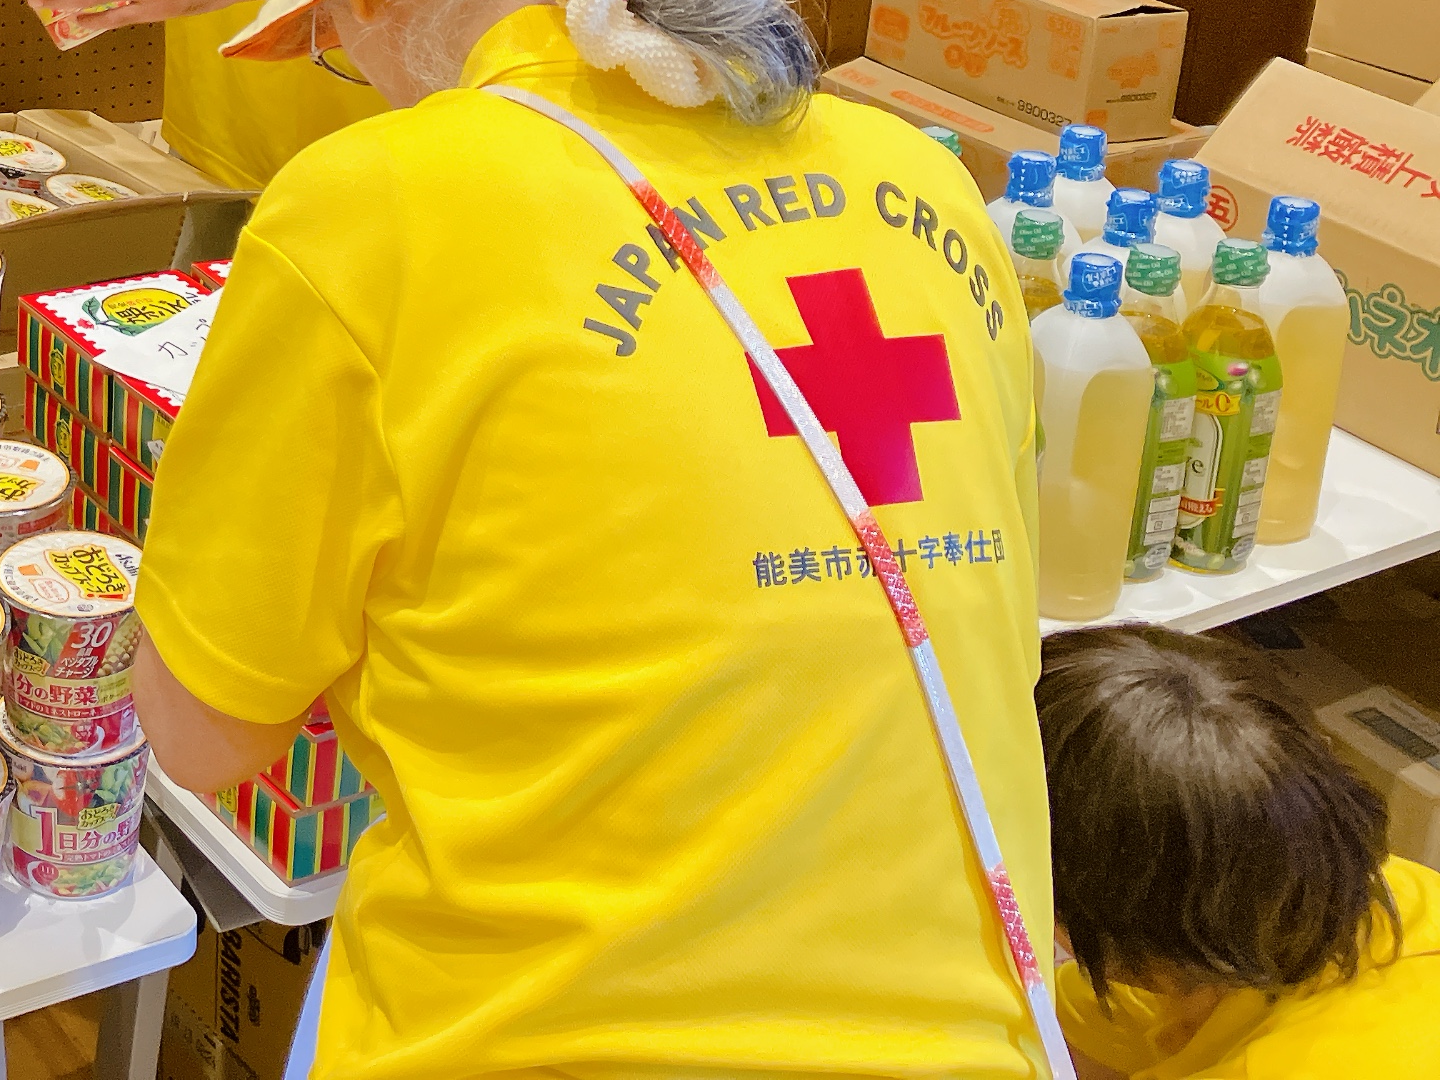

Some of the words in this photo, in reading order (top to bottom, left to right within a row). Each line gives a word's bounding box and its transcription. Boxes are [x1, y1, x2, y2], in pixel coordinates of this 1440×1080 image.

[723, 172, 847, 231] RED
[875, 181, 1004, 341] CROSS
[71, 621, 113, 649] 30
